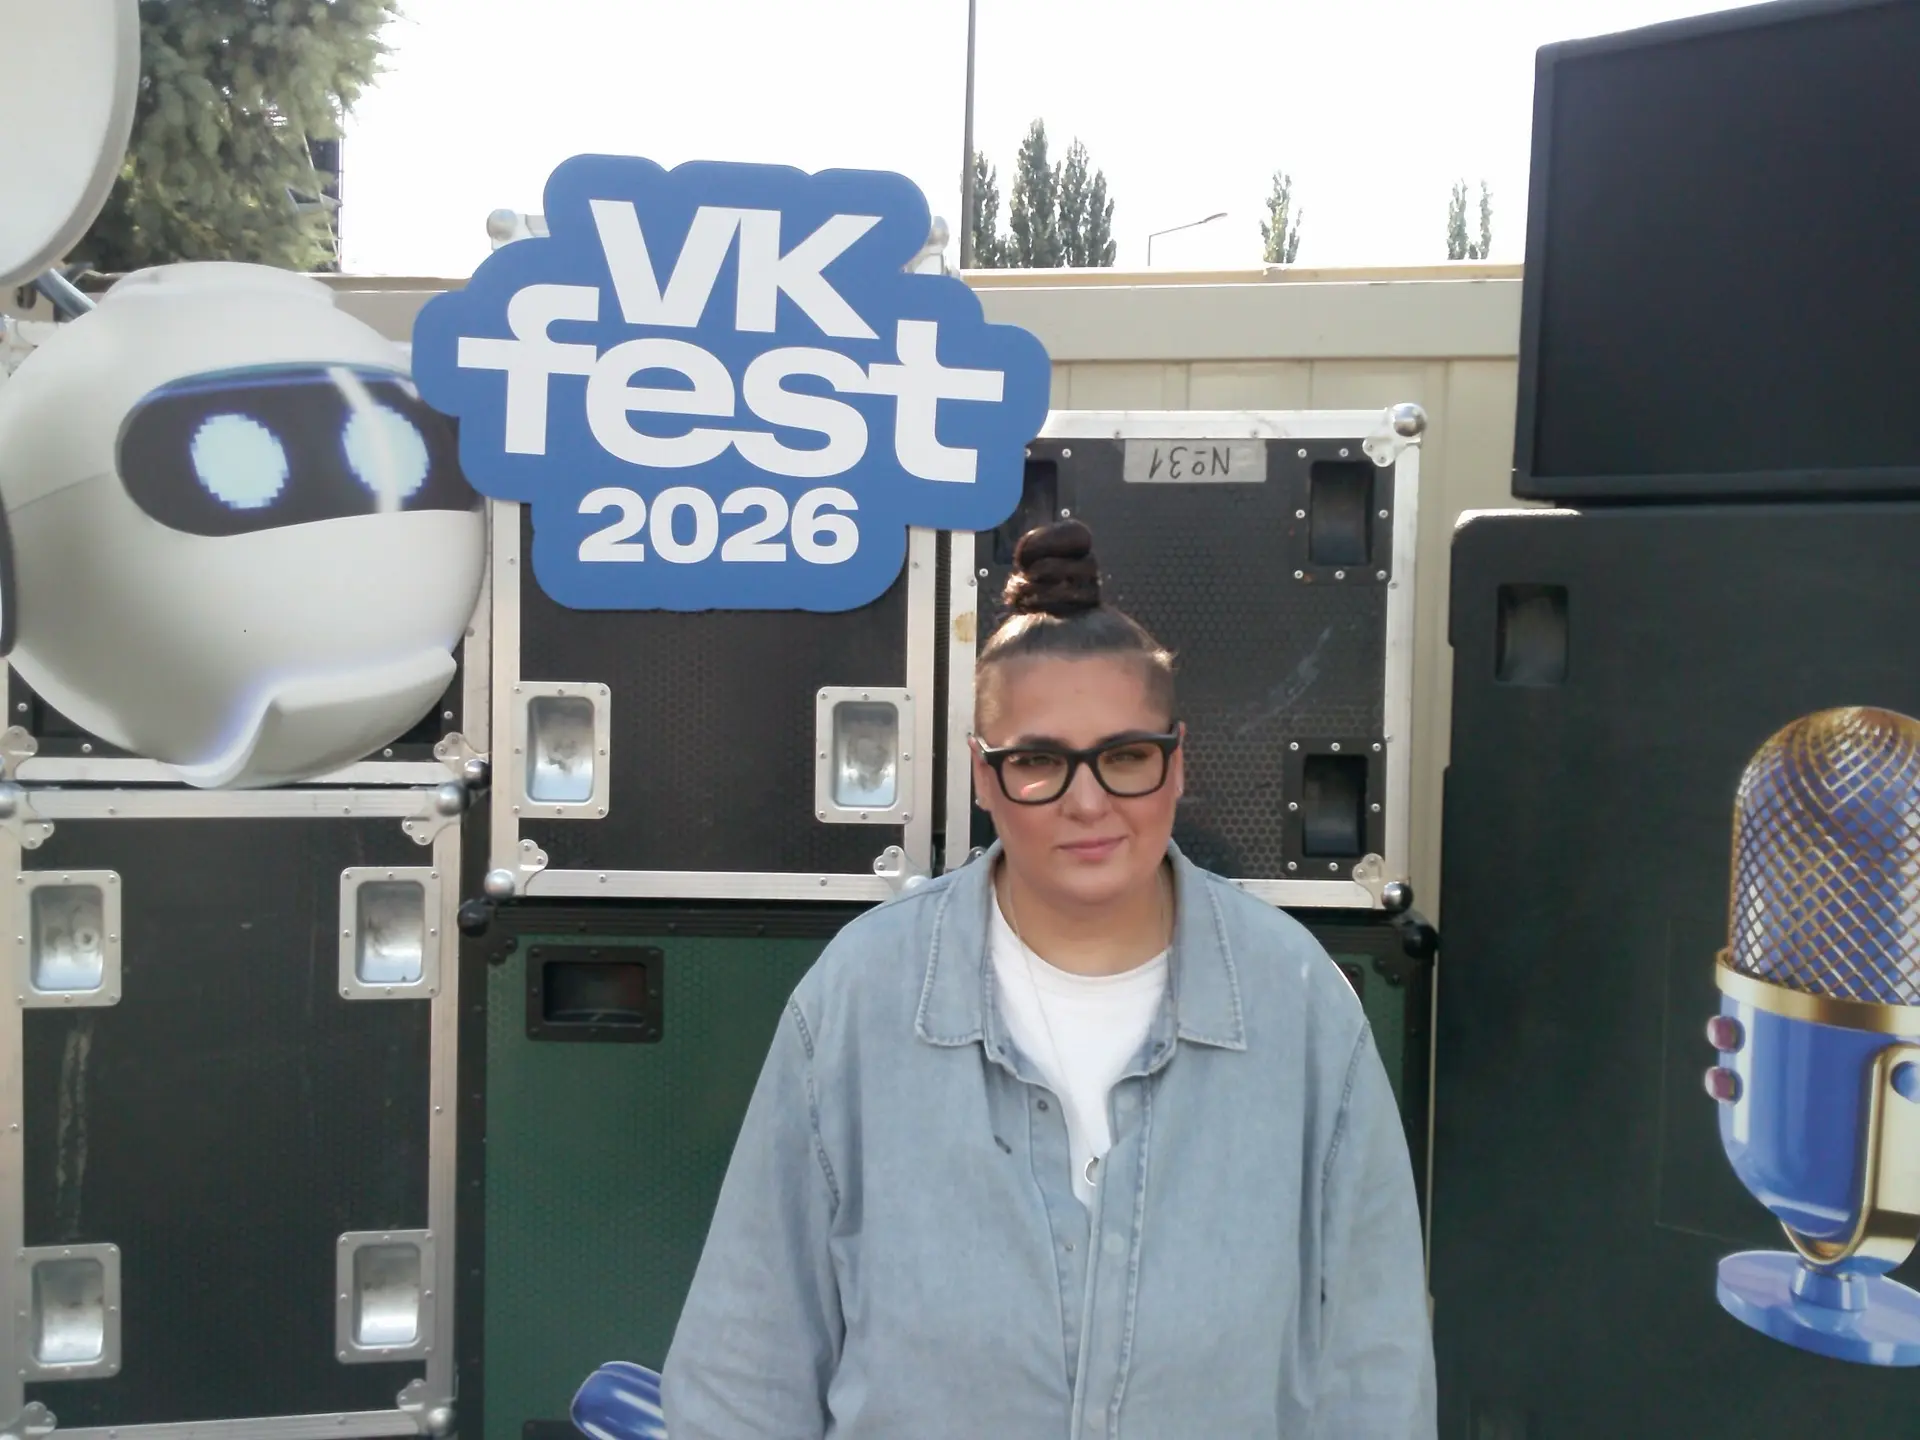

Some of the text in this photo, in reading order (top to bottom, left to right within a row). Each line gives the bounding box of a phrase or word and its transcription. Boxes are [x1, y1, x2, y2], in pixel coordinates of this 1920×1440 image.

[588, 198, 884, 340] VK
[457, 283, 1005, 484] fest
[577, 486, 860, 565] 2026
